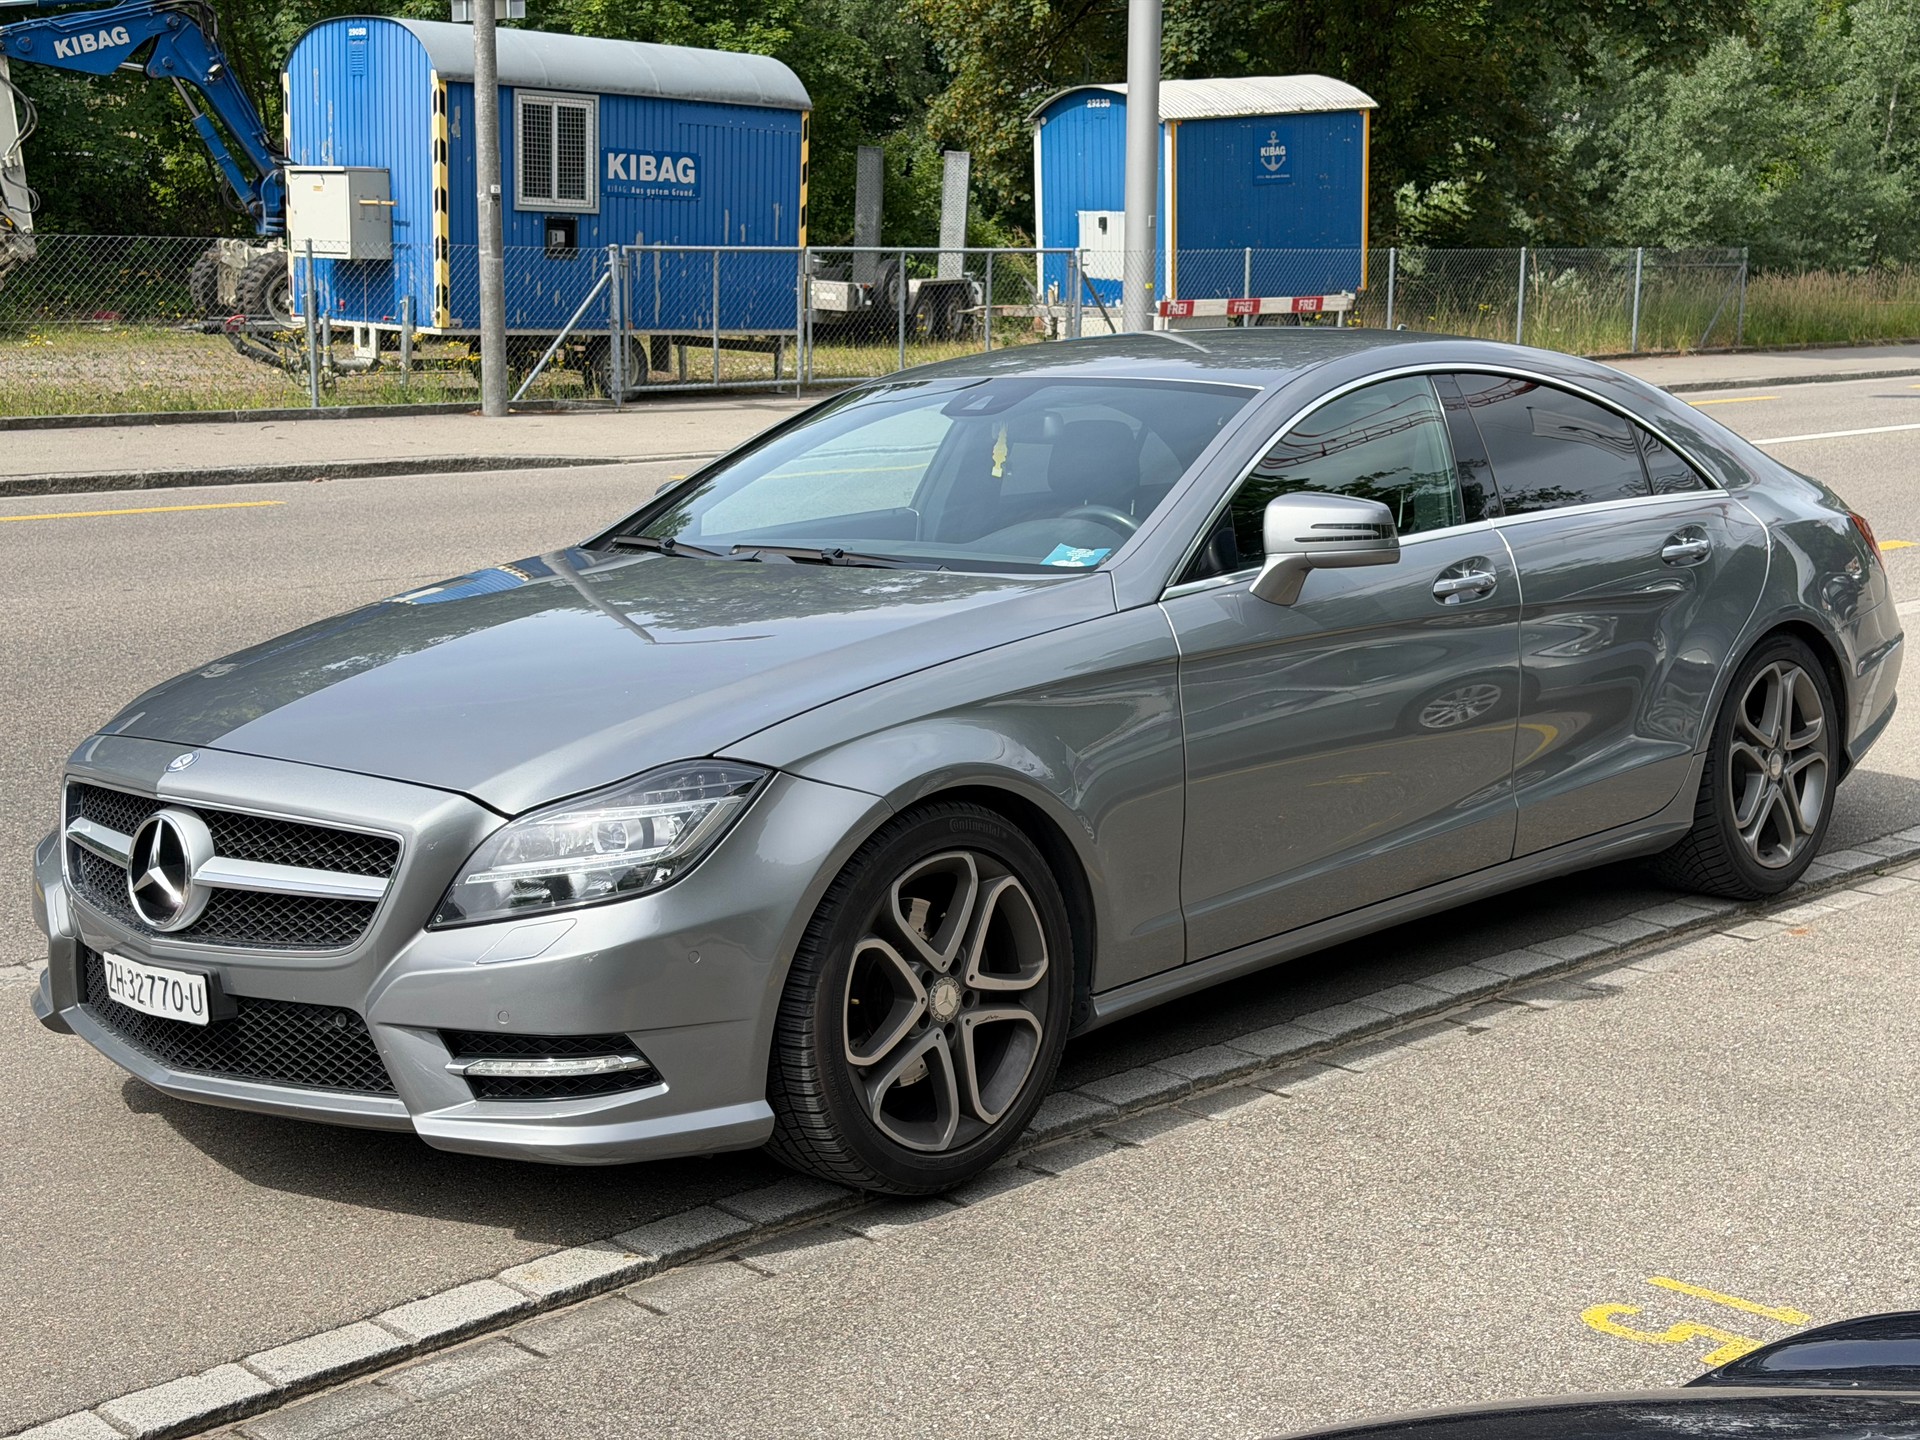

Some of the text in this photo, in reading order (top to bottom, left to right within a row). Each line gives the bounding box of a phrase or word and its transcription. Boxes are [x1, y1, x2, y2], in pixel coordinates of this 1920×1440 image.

[53, 26, 130, 59] KIBAG
[1260, 145, 1286, 157] KIBAG
[607, 152, 696, 184] KIBAG
[631, 186, 644, 194] Aus
[1166, 302, 1188, 315] FREI
[1233, 301, 1254, 313] FREI
[1298, 298, 1318, 311] FREI
[949, 818, 1000, 837] Continental
